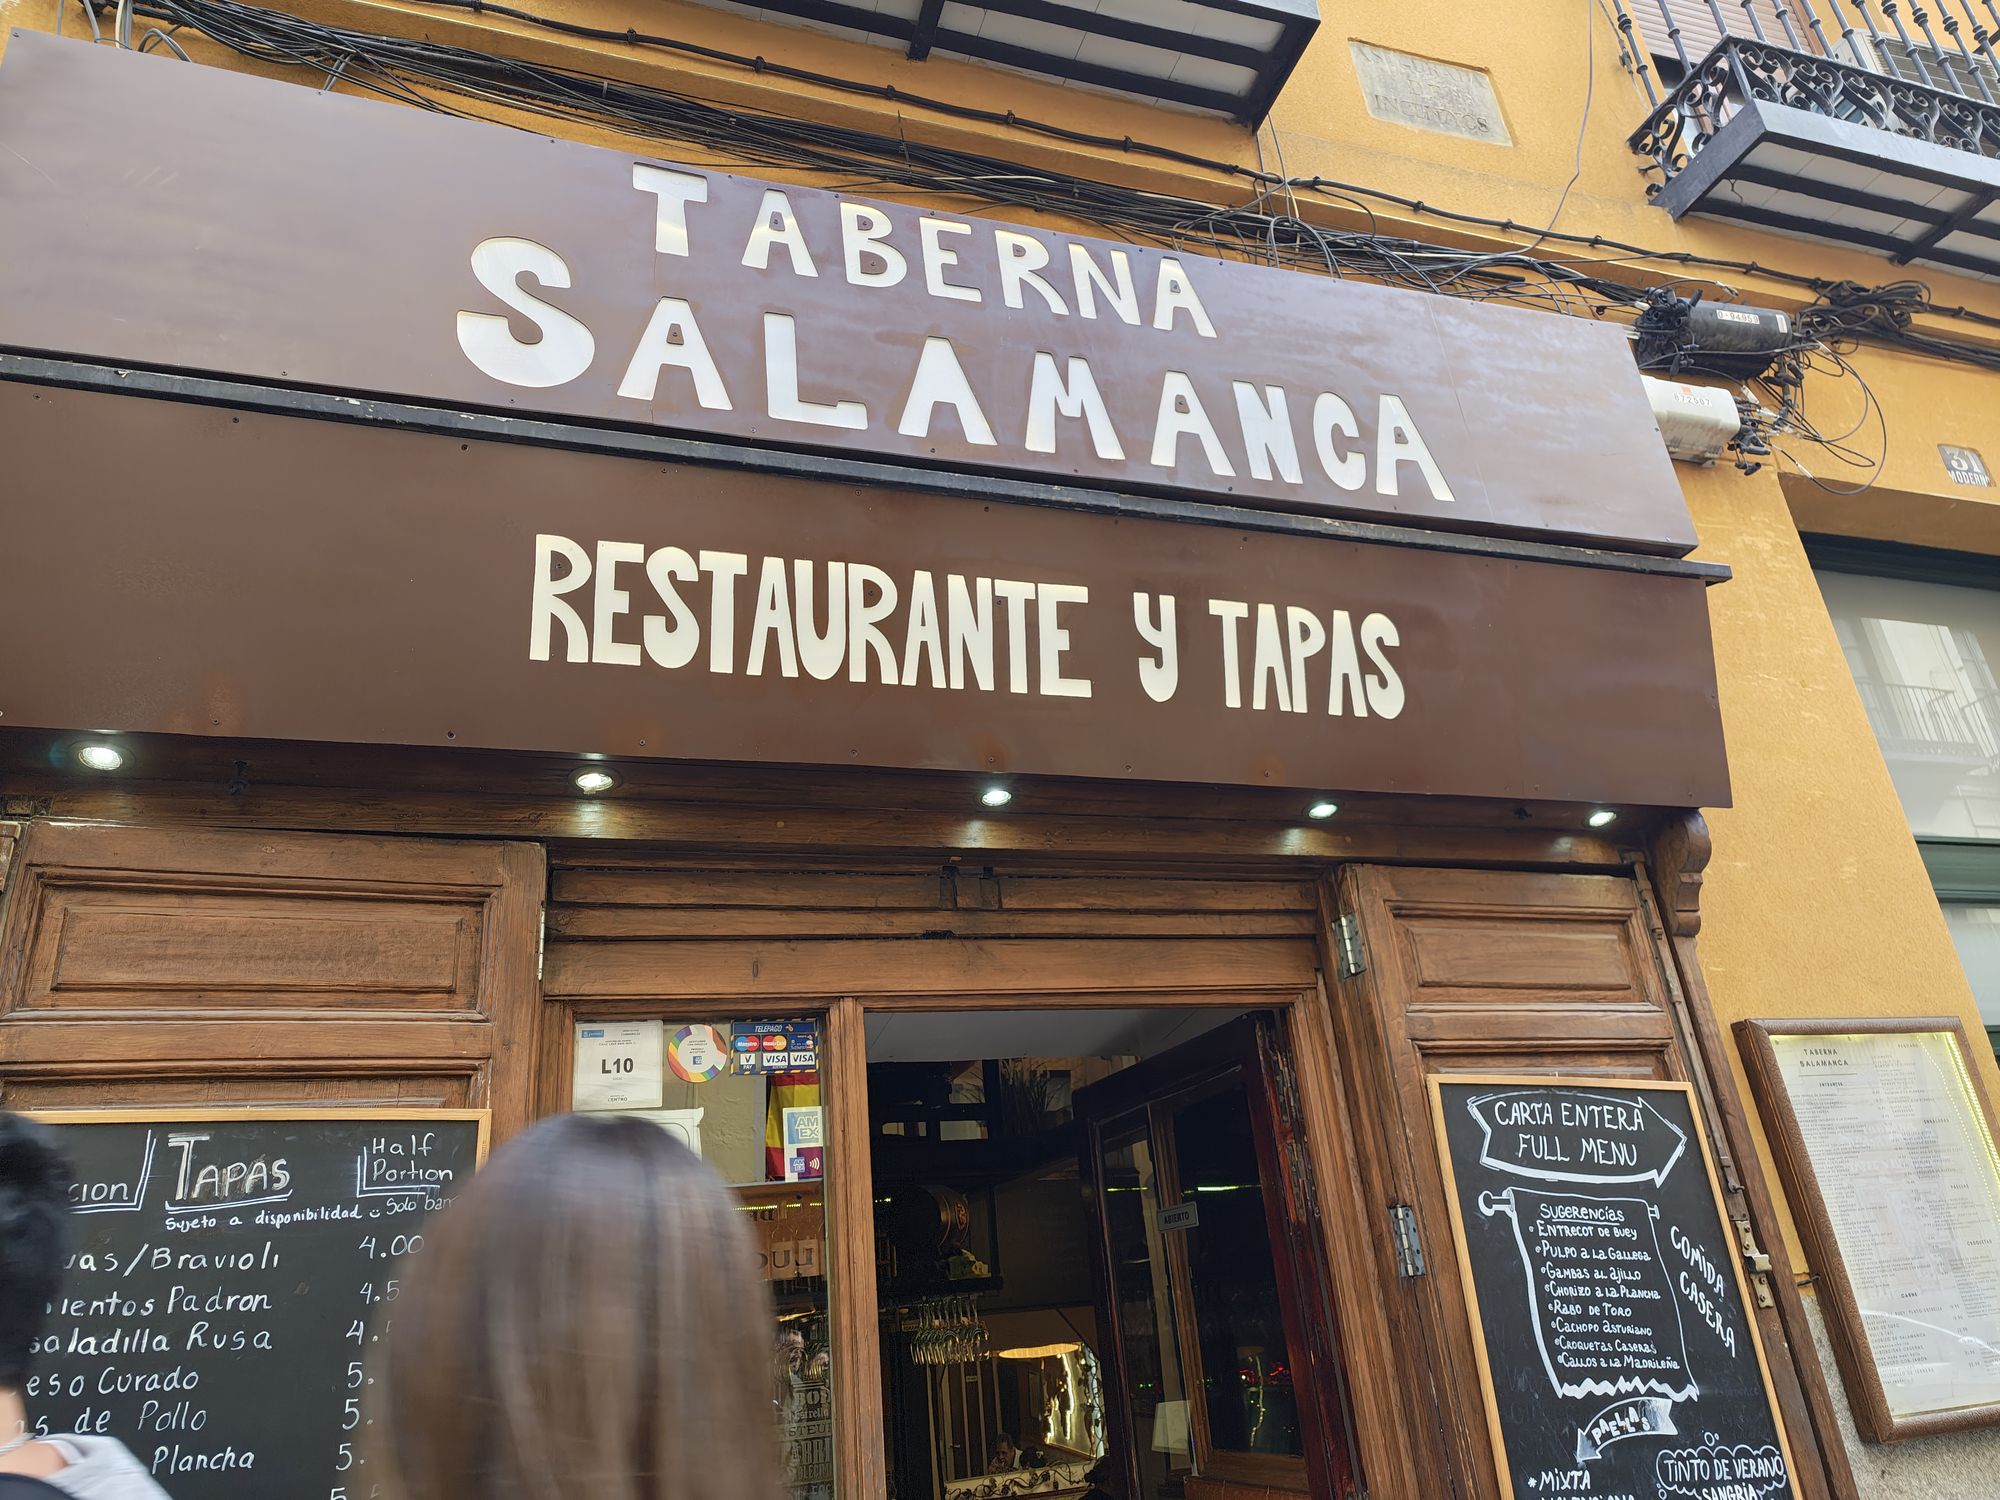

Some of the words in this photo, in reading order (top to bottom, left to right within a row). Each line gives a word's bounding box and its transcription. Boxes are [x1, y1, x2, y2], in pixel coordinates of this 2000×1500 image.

[632, 162, 1218, 339] TABERNA
[457, 237, 1455, 502] SALAMANCA
[1946, 450, 1982, 473] 31
[530, 534, 1093, 698] RESTAURANTE
[1210, 600, 1405, 719] TAPAS
[754, 1025, 782, 1033] TELEPAGO
[601, 1057, 634, 1075] L10
[766, 1055, 787, 1063] VISA
[792, 1054, 814, 1062] VISA
[1495, 1101, 1553, 1126] CARTA
[1562, 1103, 1645, 1131] ENTERA
[372, 1133, 435, 1156] Half
[1518, 1134, 1569, 1162] FULL
[1580, 1138, 1637, 1166] MENU
[168, 1132, 291, 1201] TAPAS
[372, 1158, 453, 1181] Portion
[166, 1215, 217, 1234] Sujeto
[230, 1217, 243, 1226] a
[255, 1204, 363, 1229] disponibilidad
[386, 1198, 417, 1216] Solo
[1164, 1211, 1190, 1225] ABIERTO
[359, 1235, 425, 1259] 4.00
[167, 1286, 272, 1316] Padron
[1680, 1271, 1736, 1358] CASERA
[186, 1320, 273, 1350] Rusa
[26, 1373, 85, 1397] eso
[98, 1366, 199, 1395] Curado
[74, 1407, 111, 1434] de
[138, 1401, 207, 1432] Pollo
[1591, 1406, 1651, 1445] PAELLAS
[151, 1444, 256, 1475] Plancha
[1713, 1458, 1733, 1480] DE
[1735, 1455, 1785, 1479] VERANO
